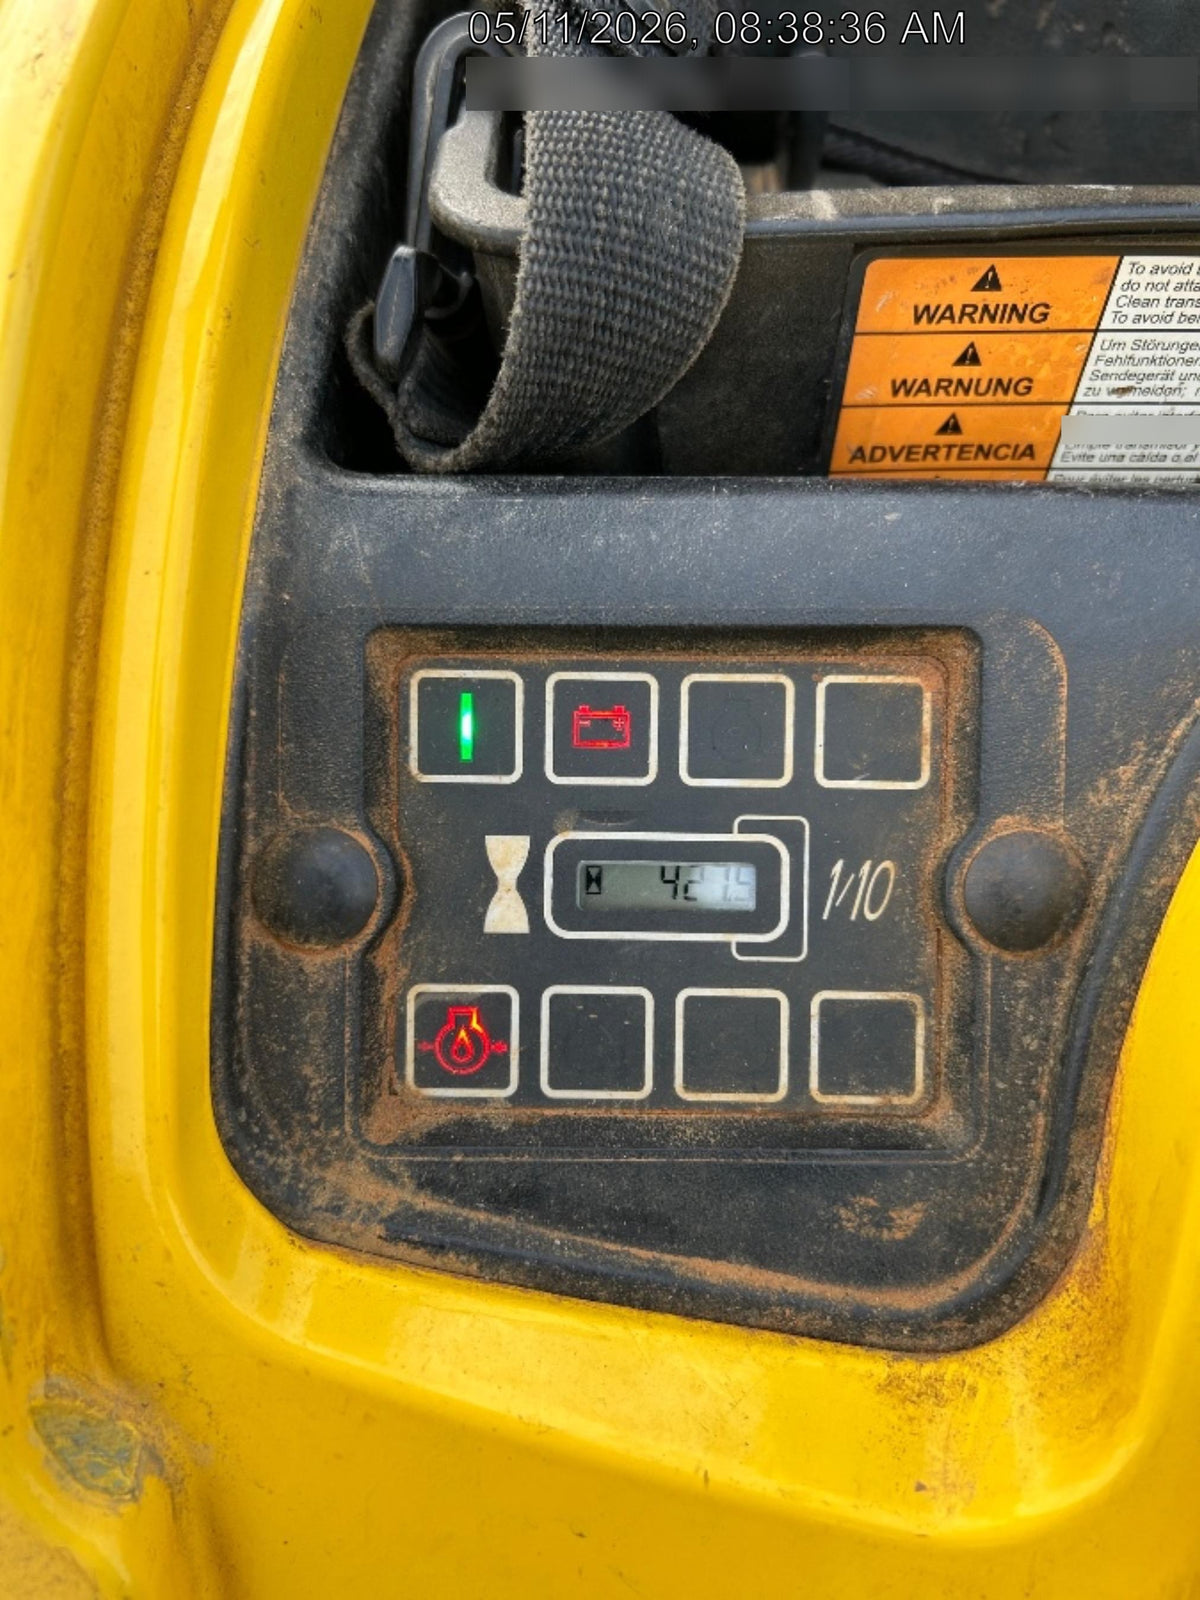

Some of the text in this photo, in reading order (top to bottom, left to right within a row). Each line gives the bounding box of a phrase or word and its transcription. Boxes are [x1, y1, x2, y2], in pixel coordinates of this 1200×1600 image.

[1128, 261, 1146, 275] To
[1149, 261, 1194, 275] avoid
[1120, 279, 1141, 292] do
[1144, 279, 1171, 292] not
[1115, 294, 1160, 308] Clean
[913, 302, 1051, 325] WARNING
[1111, 310, 1129, 324] To
[1131, 310, 1175, 324] avoid
[1100, 339, 1127, 351] Um
[1089, 369, 1176, 384] Sendegerät
[890, 376, 1034, 398] WARNUNG
[1083, 387, 1102, 397] zu
[848, 443, 1036, 465] ADVERTENCIA
[1060, 451, 1096, 463] Evite
[822, 859, 896, 921] 1/10
